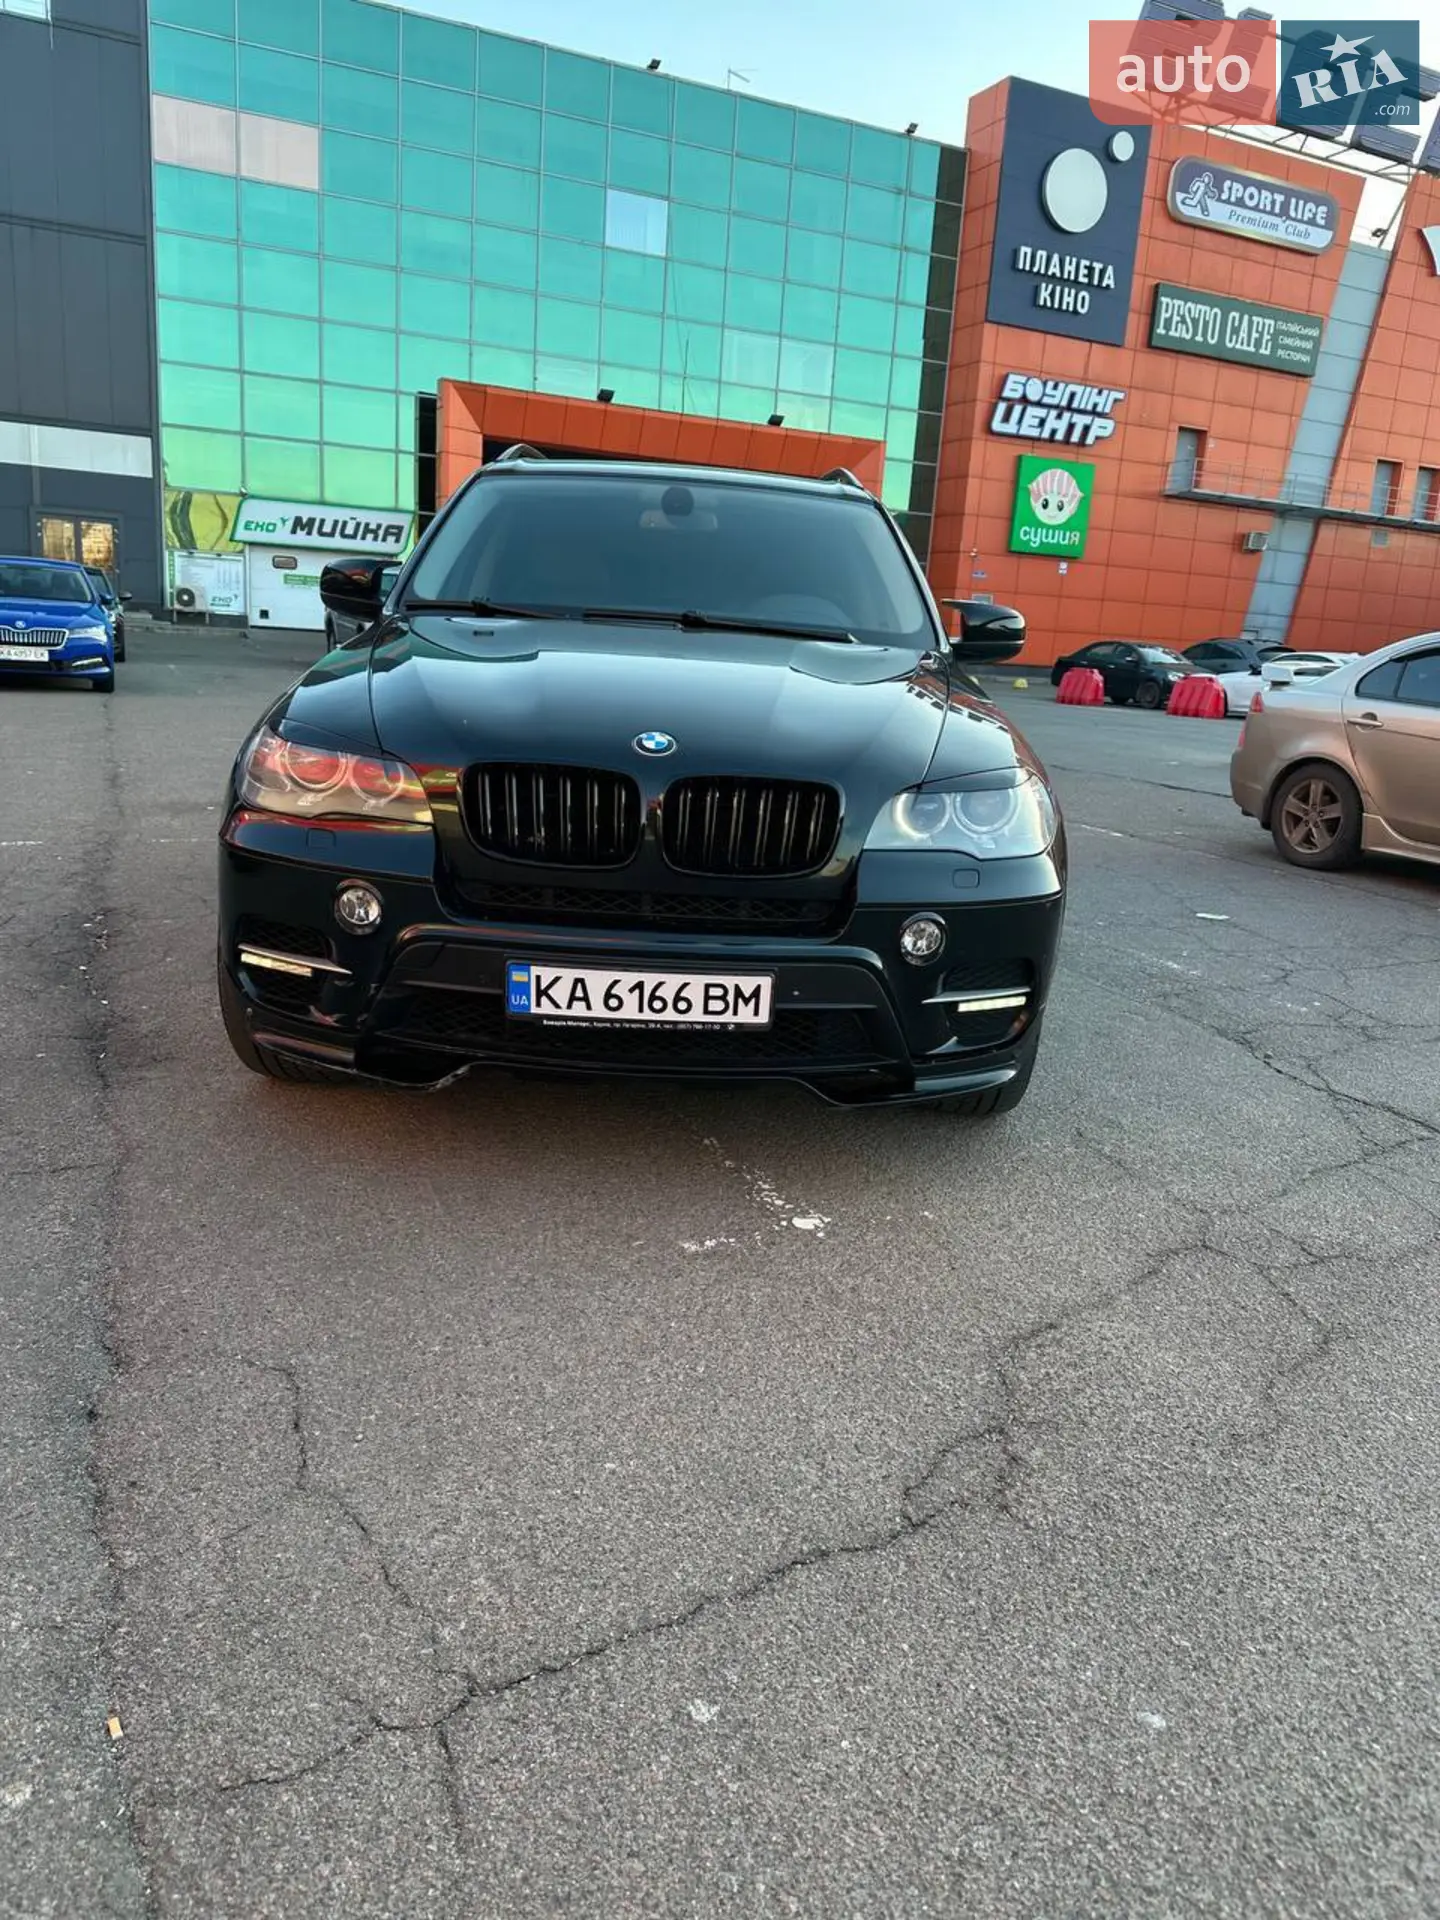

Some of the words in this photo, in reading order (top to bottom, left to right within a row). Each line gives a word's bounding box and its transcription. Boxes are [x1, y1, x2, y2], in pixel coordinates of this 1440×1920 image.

[1220, 179, 1285, 214] SPORT
[1288, 197, 1329, 226] LIFE
[1227, 209, 1280, 233] Premium
[1284, 223, 1312, 240] Club
[1017, 245, 1116, 289] ПЛАНЕТА
[1038, 282, 1091, 315] КІНО
[1155, 296, 1222, 345] PESTO
[1225, 311, 1276, 356] CAFE
[1000, 372, 1127, 414] БОУЛІНГ
[990, 400, 1118, 446] ЦЕНТР
[290, 515, 405, 544] МИЙКА
[1019, 526, 1081, 548] сушия
[511, 995, 529, 1007] UA
[535, 974, 593, 1012] KA
[602, 978, 694, 1015] 6166
[702, 982, 762, 1018] BM
